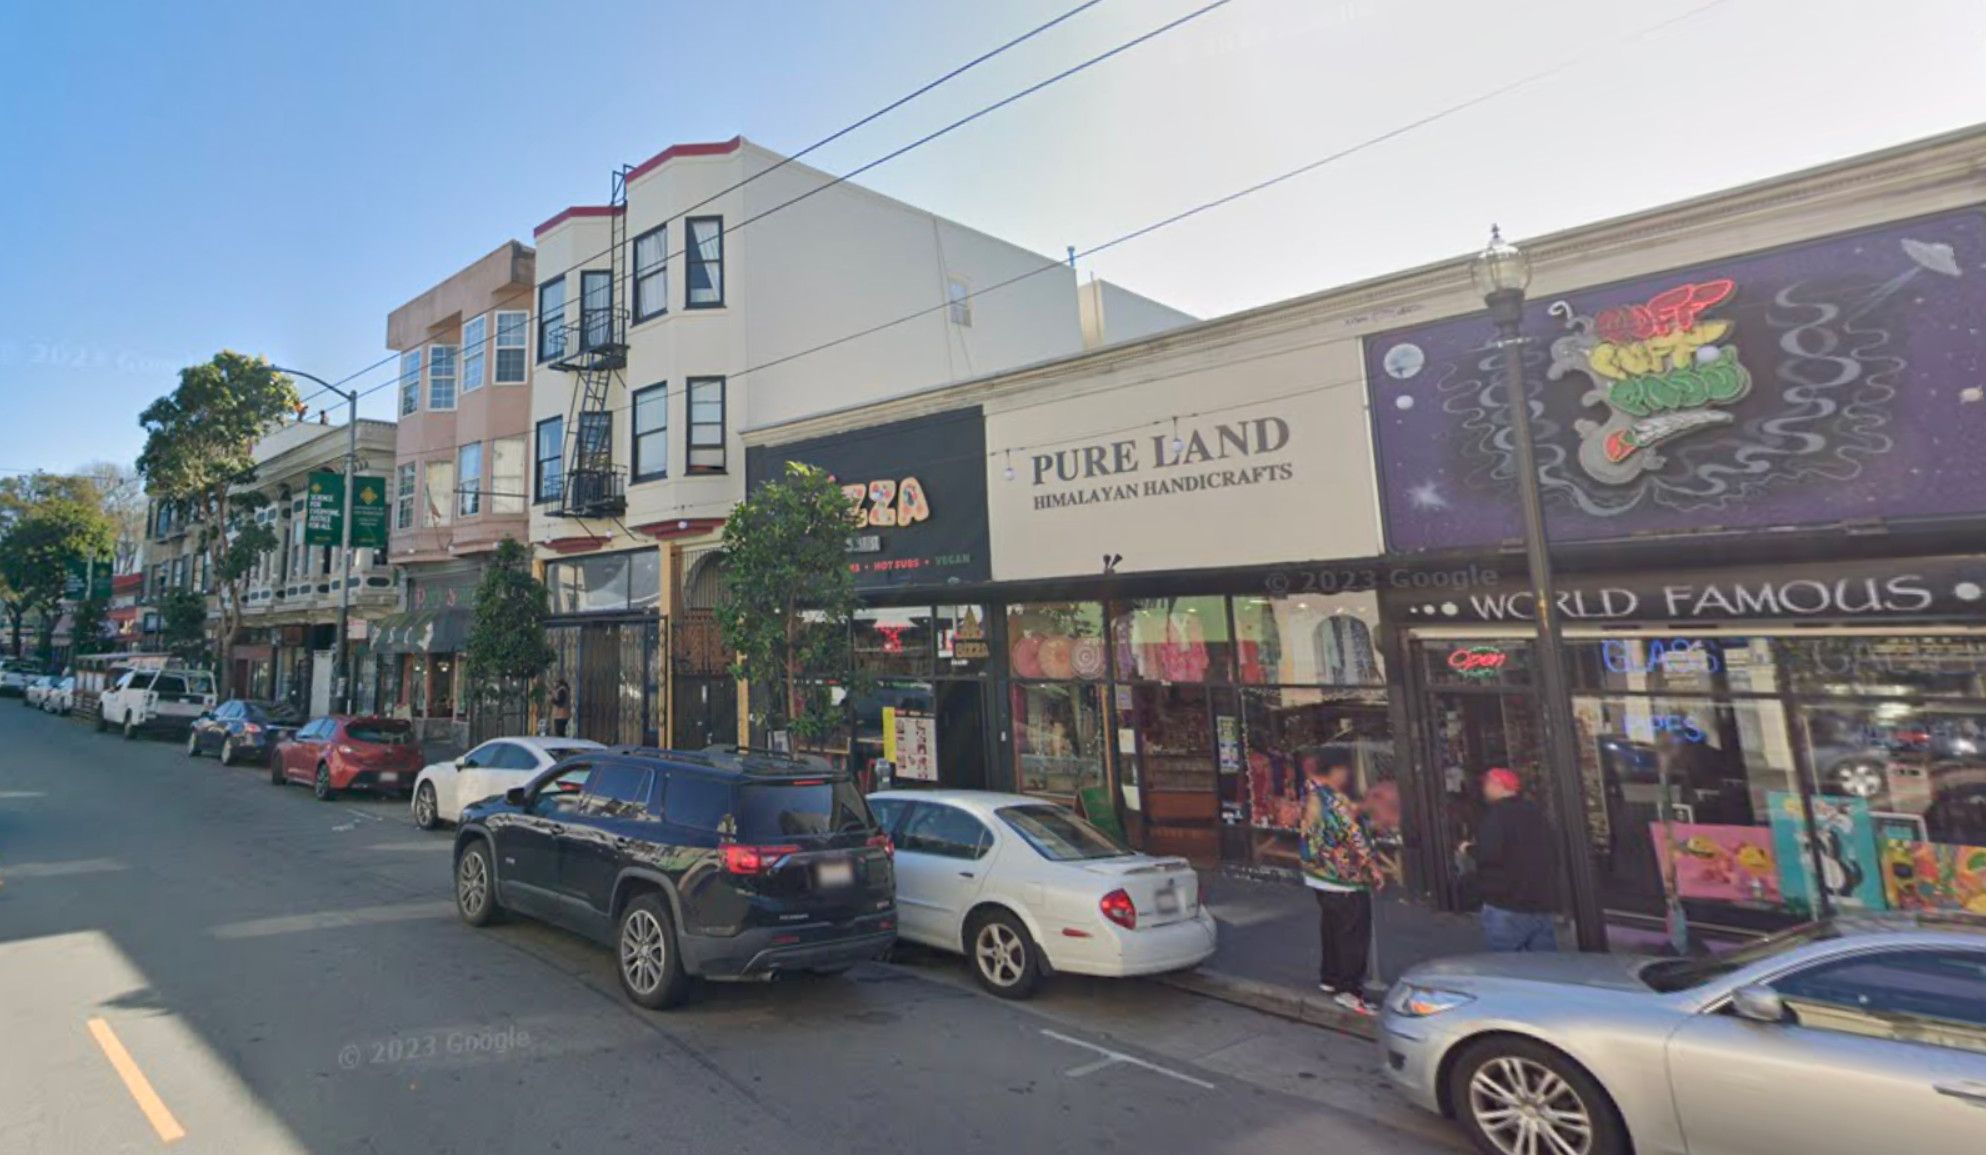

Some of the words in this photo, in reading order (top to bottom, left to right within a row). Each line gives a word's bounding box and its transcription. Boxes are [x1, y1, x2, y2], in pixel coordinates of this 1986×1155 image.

[1032, 440, 1138, 486] PURE
[1152, 416, 1290, 469] LAND
[841, 477, 930, 528] ZZA
[1033, 484, 1139, 511] HIMALAYAN
[1143, 463, 1293, 497] HANDICRAFTS
[1663, 574, 1933, 617] FAMOUS
